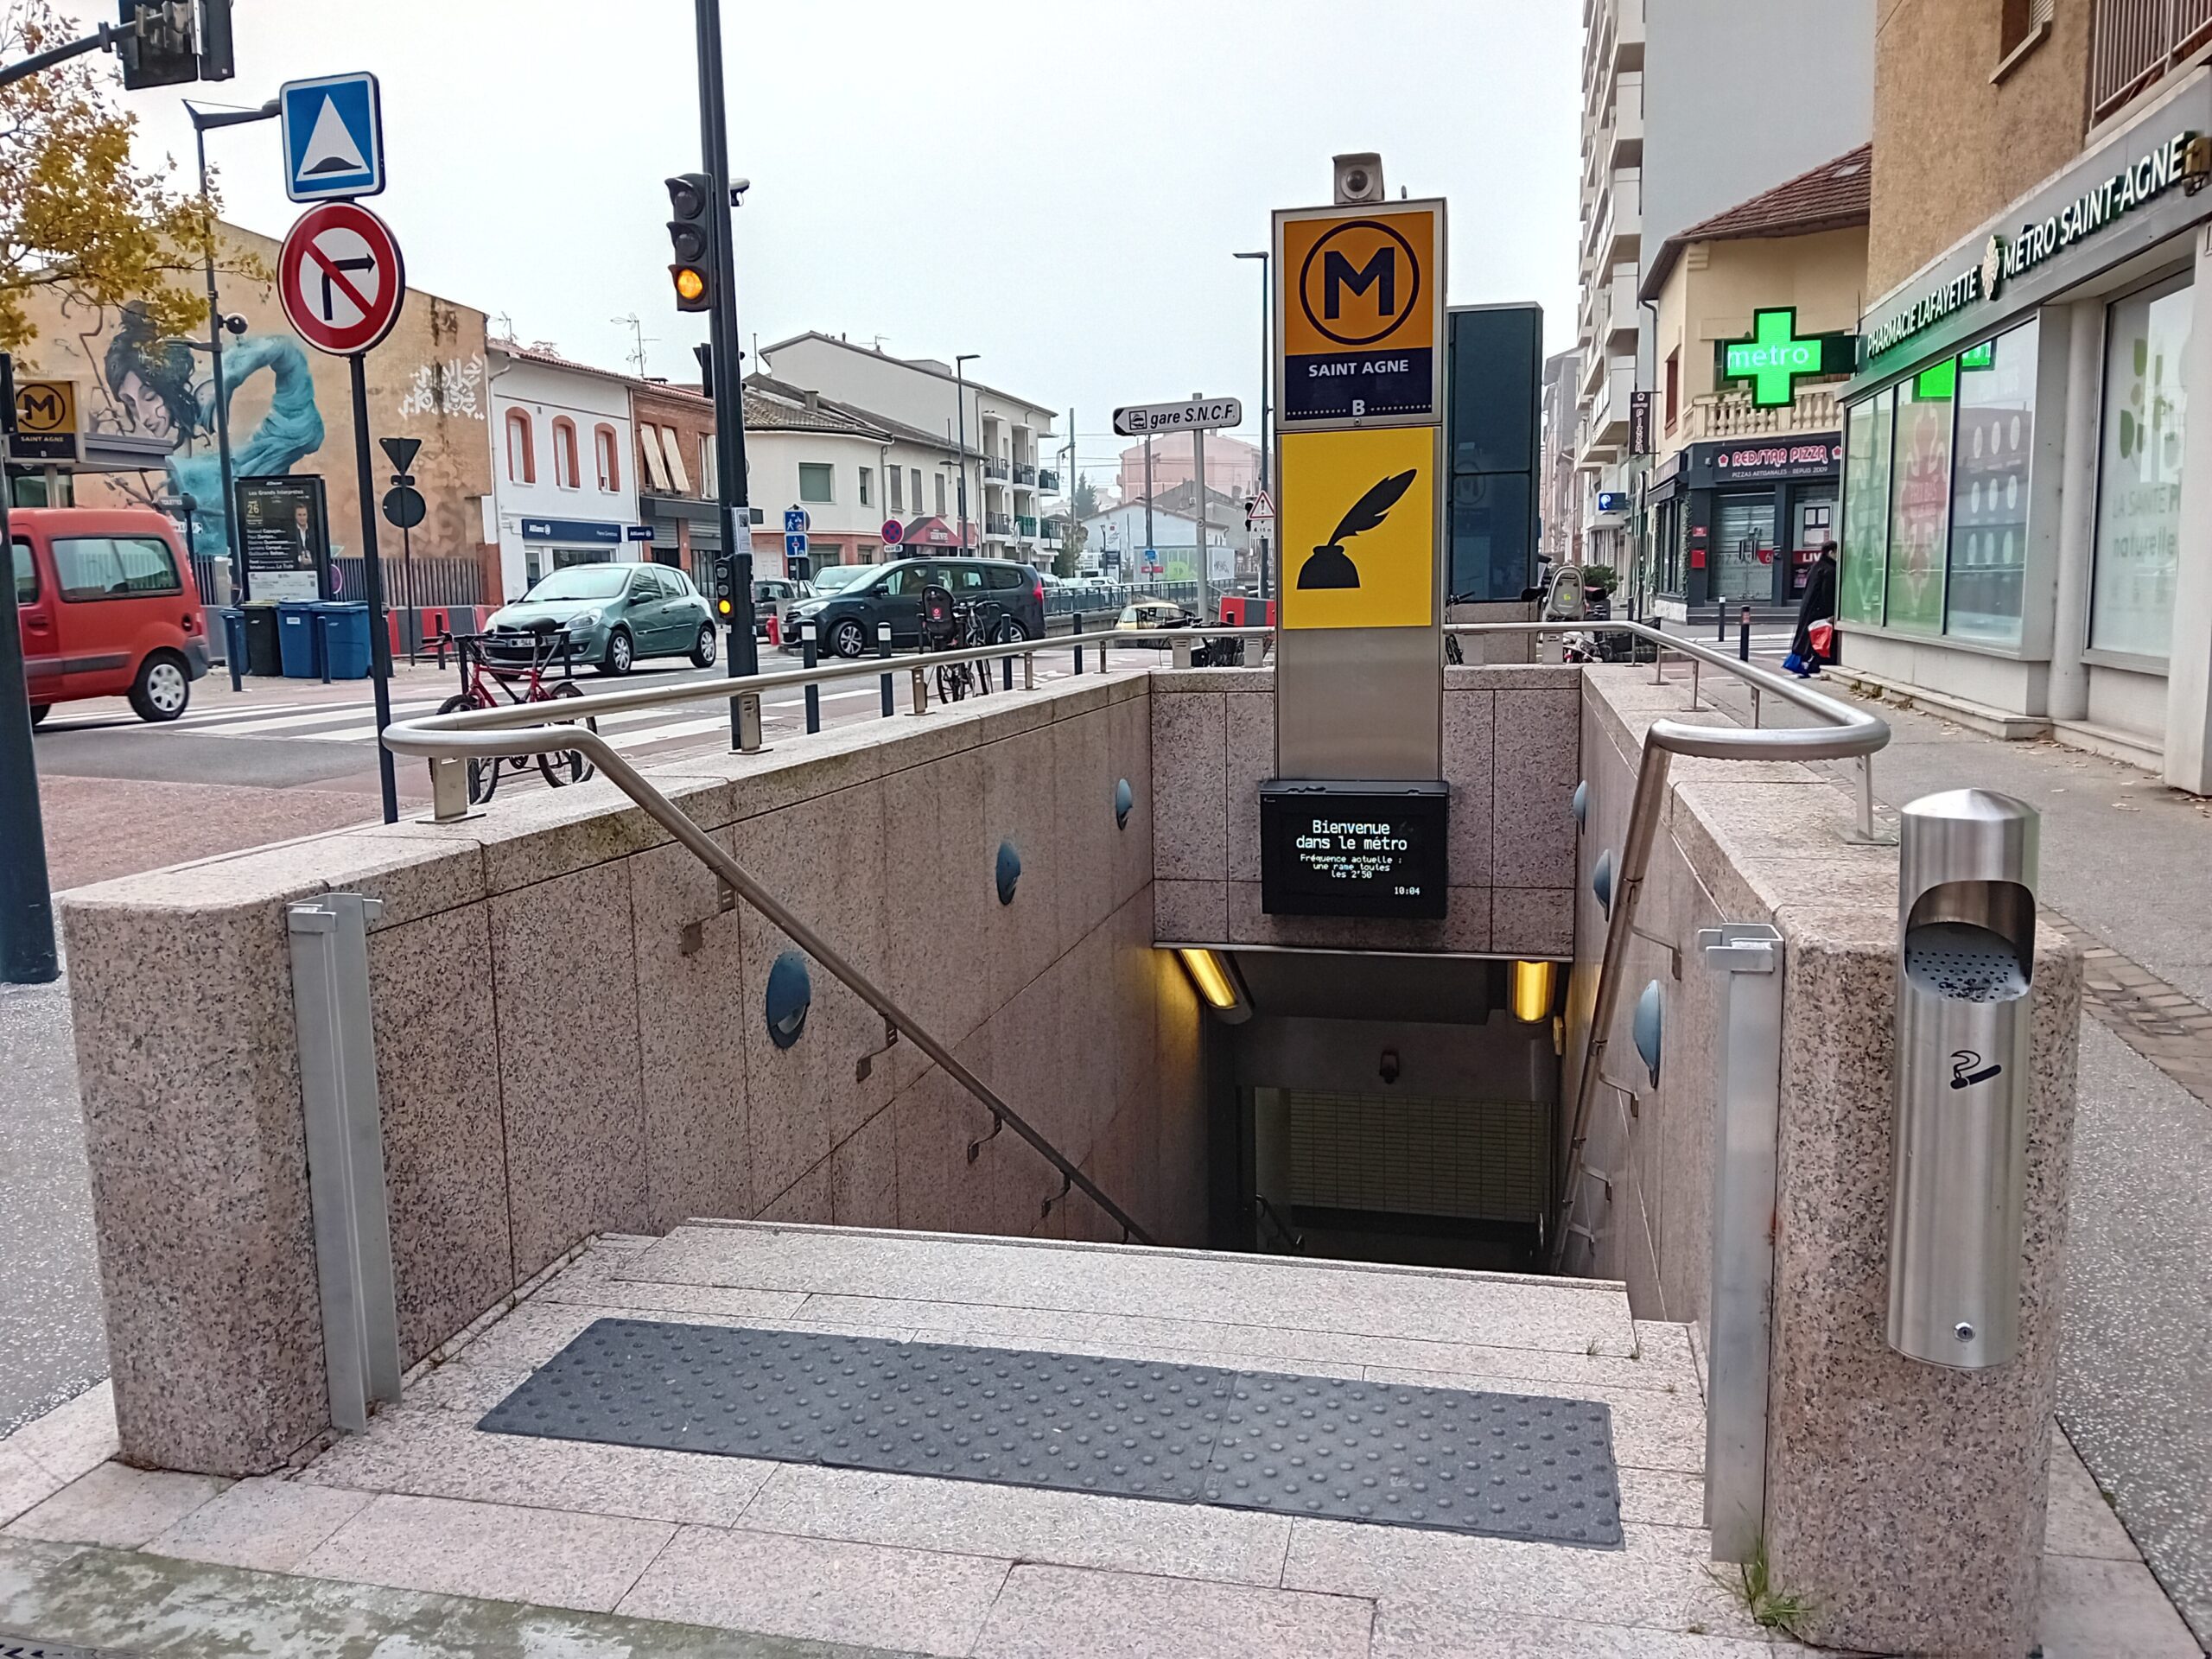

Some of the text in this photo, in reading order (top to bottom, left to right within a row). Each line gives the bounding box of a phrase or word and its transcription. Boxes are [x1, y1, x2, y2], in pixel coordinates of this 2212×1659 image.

[1867, 133, 2185, 359] PHARMACIE LAFAYETTE MÉTRO SAINT-AGNE
[1324, 246, 1395, 321] M
[1727, 345, 1809, 369] metro
[1308, 359, 1409, 378] SAINT AGNE
[23, 393, 56, 421] M
[1351, 399, 1366, 416] B
[1150, 404, 1236, 429] gare S.N.C.F.
[1635, 408, 1644, 454] PIZZA
[1789, 445, 1828, 464] PIZZA
[1752, 468, 1788, 477] ARTISANALES
[247, 504, 259, 514] 26
[1802, 552, 1823, 563] LIV
[1312, 819, 1390, 836] Bienvenue
[1295, 835, 1408, 851] dans le métro
[1300, 854, 1346, 863] Fréquence
[1351, 855, 1393, 864] actuelle
[1360, 862, 1390, 872] toutes
[1332, 870, 1372, 880] les 2'50
[1394, 886, 1421, 896] 10:04
